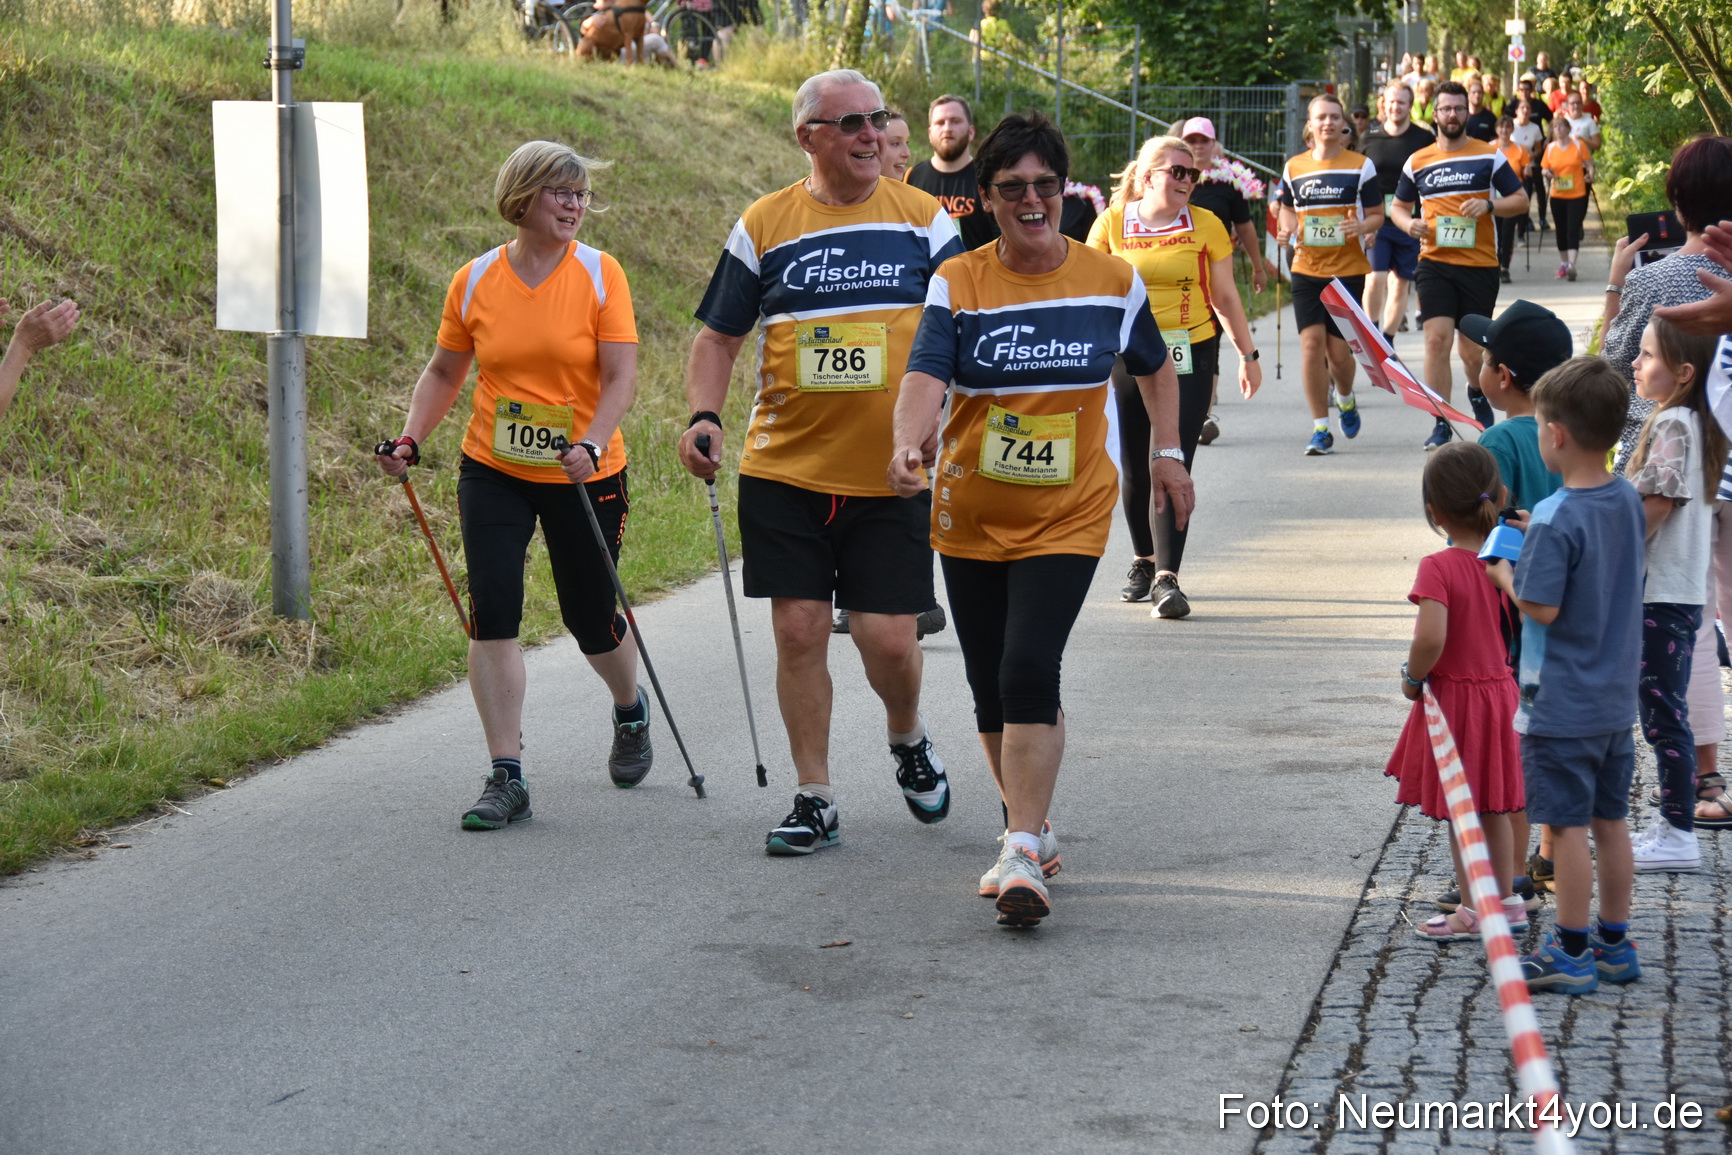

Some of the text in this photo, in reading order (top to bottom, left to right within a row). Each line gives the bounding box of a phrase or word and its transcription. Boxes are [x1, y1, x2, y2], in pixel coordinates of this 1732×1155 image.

[1433, 172, 1475, 184] Fischer
[1437, 180, 1471, 188] AUTOMOBILE
[1306, 185, 1344, 196] Fischer
[1312, 227, 1335, 238] 762
[1444, 227, 1466, 239] 777
[1122, 241, 1153, 250] MAX
[804, 260, 905, 284] Fischer
[815, 279, 900, 294] AUTOMOBILE
[993, 339, 1094, 361] Fischer
[1168, 346, 1183, 362] 6
[814, 347, 866, 372] 786
[1003, 358, 1088, 371] AUTOMOBILE
[844, 373, 869, 381] August
[510, 445, 524, 454] Hink
[526, 448, 543, 456] Edith
[1000, 436, 1054, 465] 744
[993, 468, 1011, 476] Fischer
[994, 461, 1057, 473] Fischer Marianne
